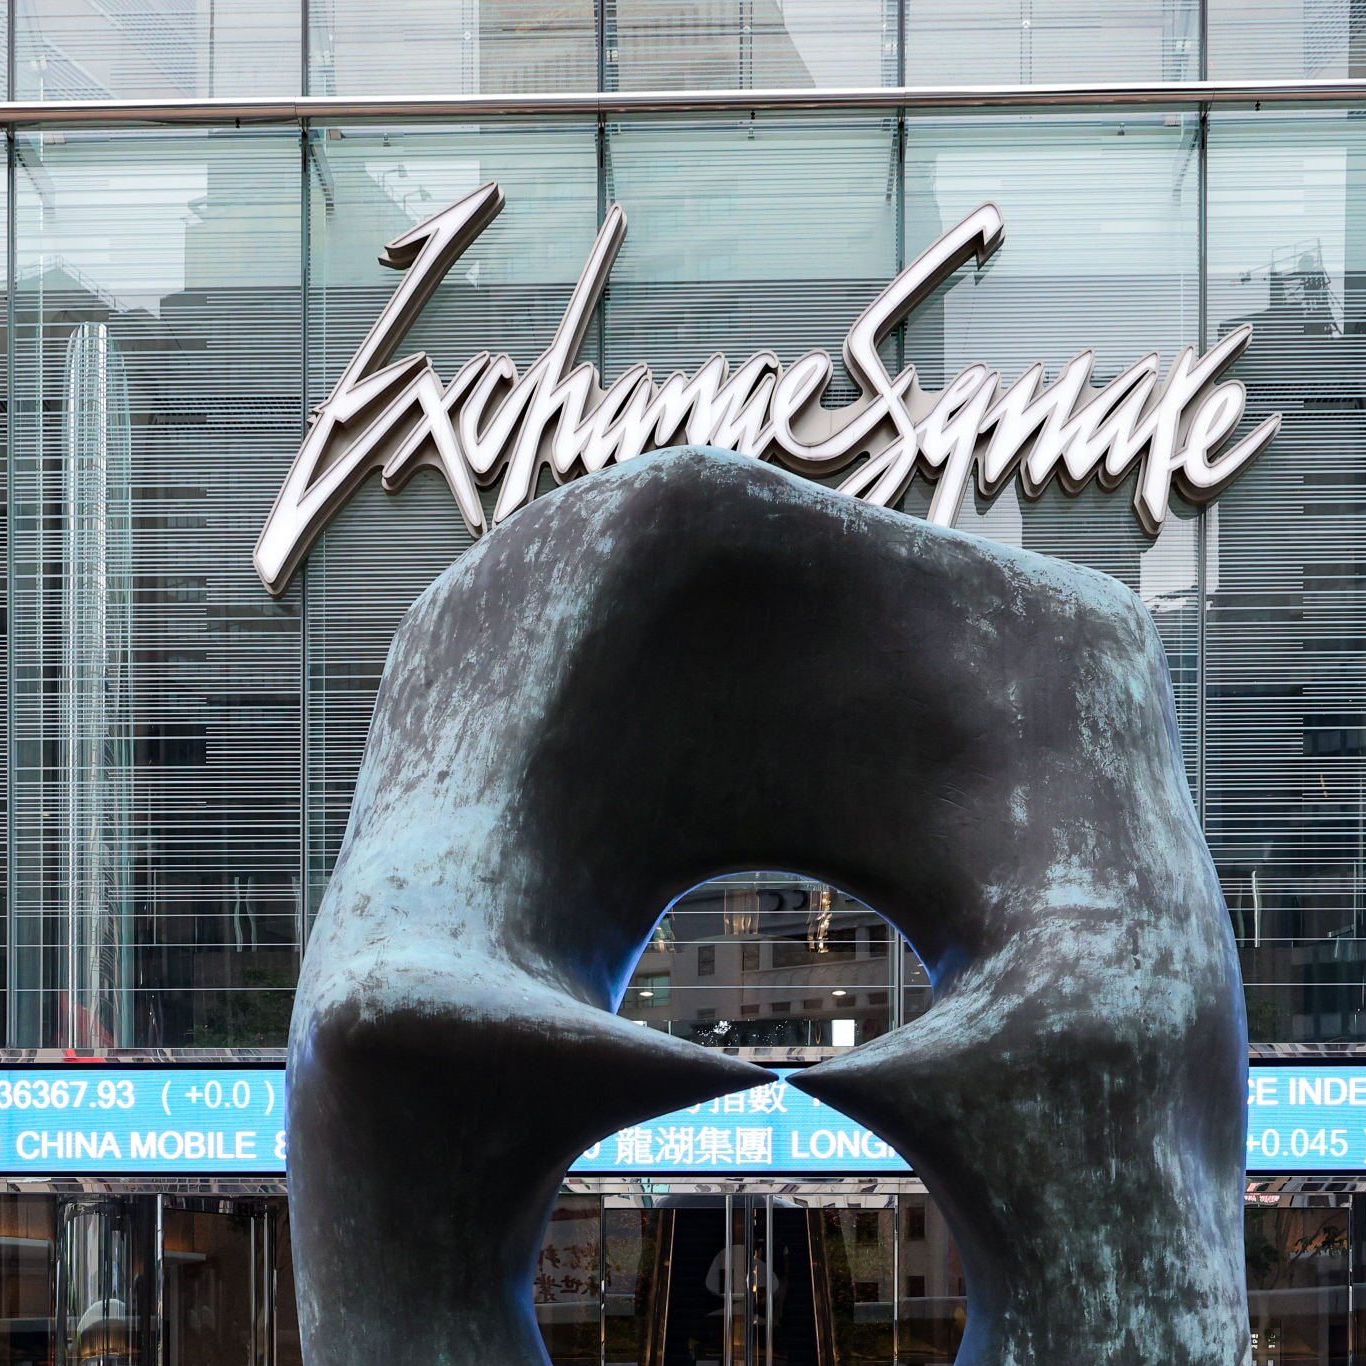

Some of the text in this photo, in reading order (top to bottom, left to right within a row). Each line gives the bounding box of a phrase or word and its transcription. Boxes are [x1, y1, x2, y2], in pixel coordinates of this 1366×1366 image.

[252, 181, 834, 598] Exchange
[186, 1081, 250, 1108] +0.0
[17, 1131, 121, 1159] CHINA
[131, 1131, 257, 1159] MOBILE
[616, 1126, 772, 1164] 龍湖集團
